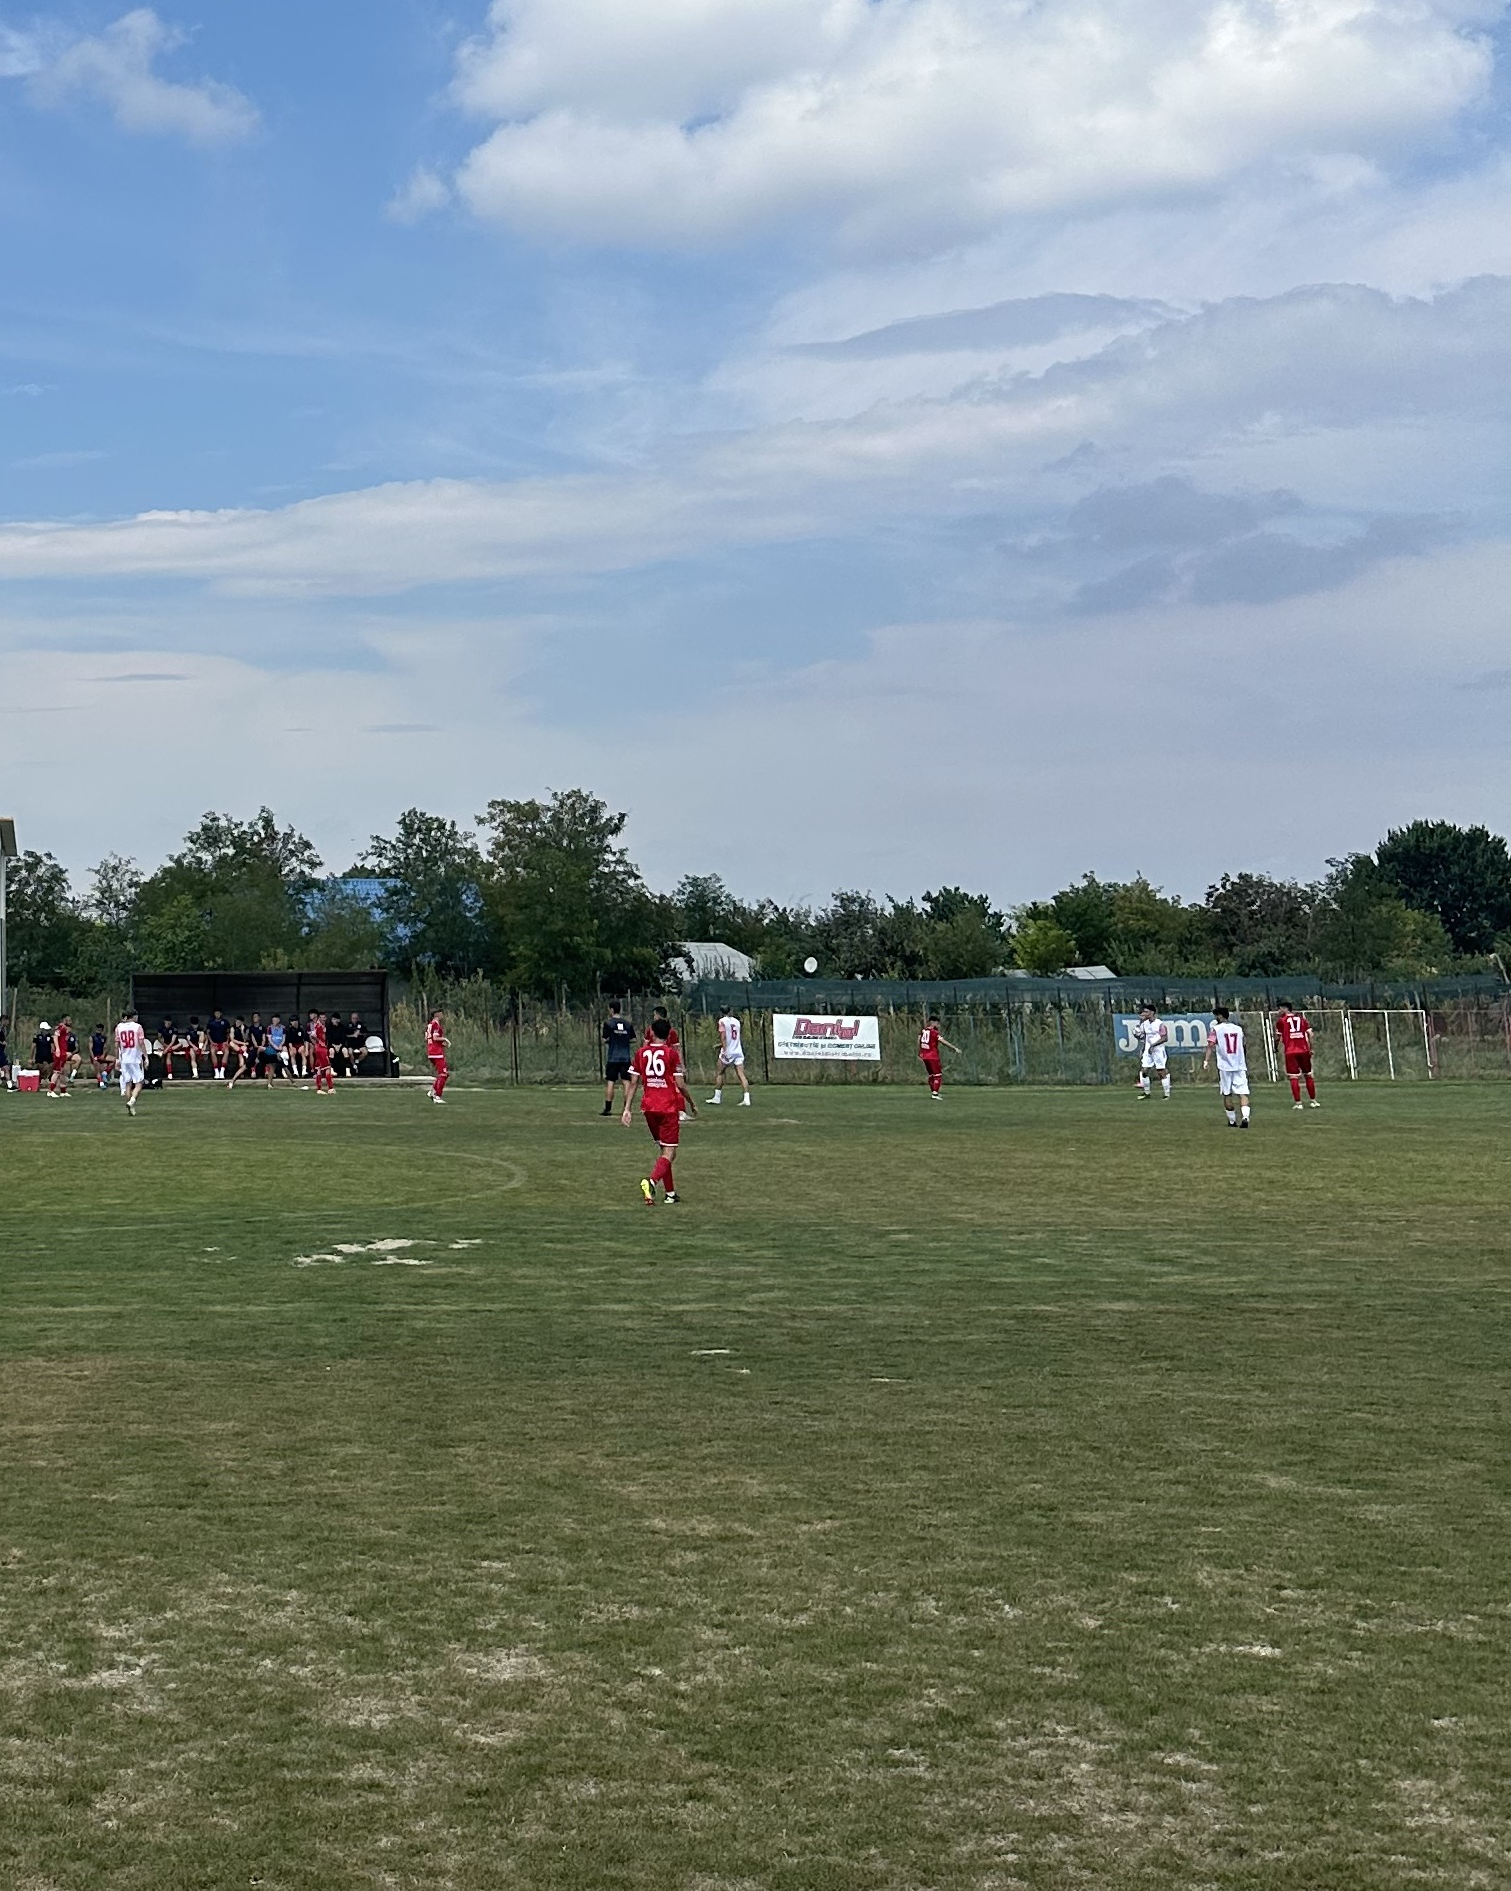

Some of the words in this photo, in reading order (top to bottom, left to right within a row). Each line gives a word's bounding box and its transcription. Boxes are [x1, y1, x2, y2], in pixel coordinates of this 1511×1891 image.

[1287, 1017, 1301, 1032] 17
[120, 1030, 135, 1048] 98
[1224, 1033, 1237, 1054] 17
[642, 1050, 665, 1076] 26
